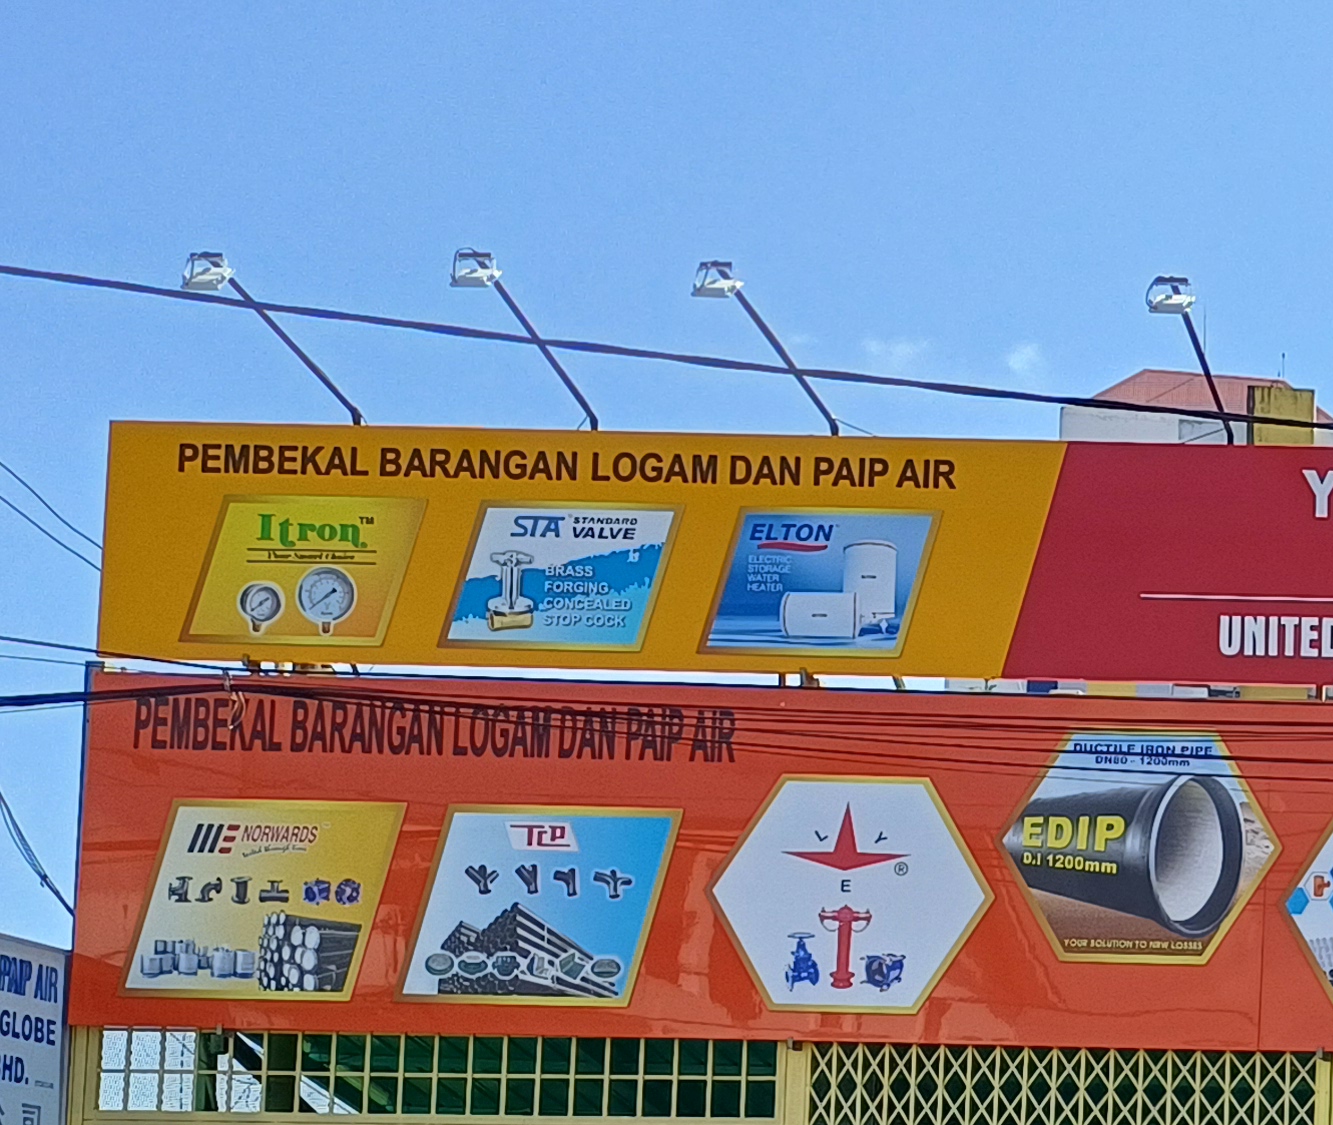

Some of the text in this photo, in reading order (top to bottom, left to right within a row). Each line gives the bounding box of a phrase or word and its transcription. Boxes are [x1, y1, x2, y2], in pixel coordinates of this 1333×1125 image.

[177, 443, 957, 489] PEMBEKAL BARANGAN LOGAM DAN PAIP AIR
[256, 513, 368, 549] Itron
[510, 515, 638, 538] STA STANDARD
[573, 527, 636, 540] VALVE
[750, 523, 834, 542] ELTON
[748, 555, 793, 565] ELECTRIC
[748, 564, 792, 574] STORAGE
[545, 565, 593, 577] BRASS
[747, 573, 779, 583] WATER
[544, 581, 609, 594] FORGING
[747, 582, 783, 592] HEATER
[543, 597, 632, 611] CONCEALED
[543, 614, 626, 627] STOP COCK
[133, 697, 283, 753] PEMBEKAL
[290, 701, 445, 758] BARANGAN
[453, 703, 551, 760] LOGAM
[558, 706, 616, 761] DAN
[241, 824, 319, 844] NORWARDS
[1021, 815, 1126, 852] EDIP
[1047, 854, 1118, 875] 1200mm
[34, 963, 58, 1003] AIR
[0, 1054, 29, 1086] HD.
